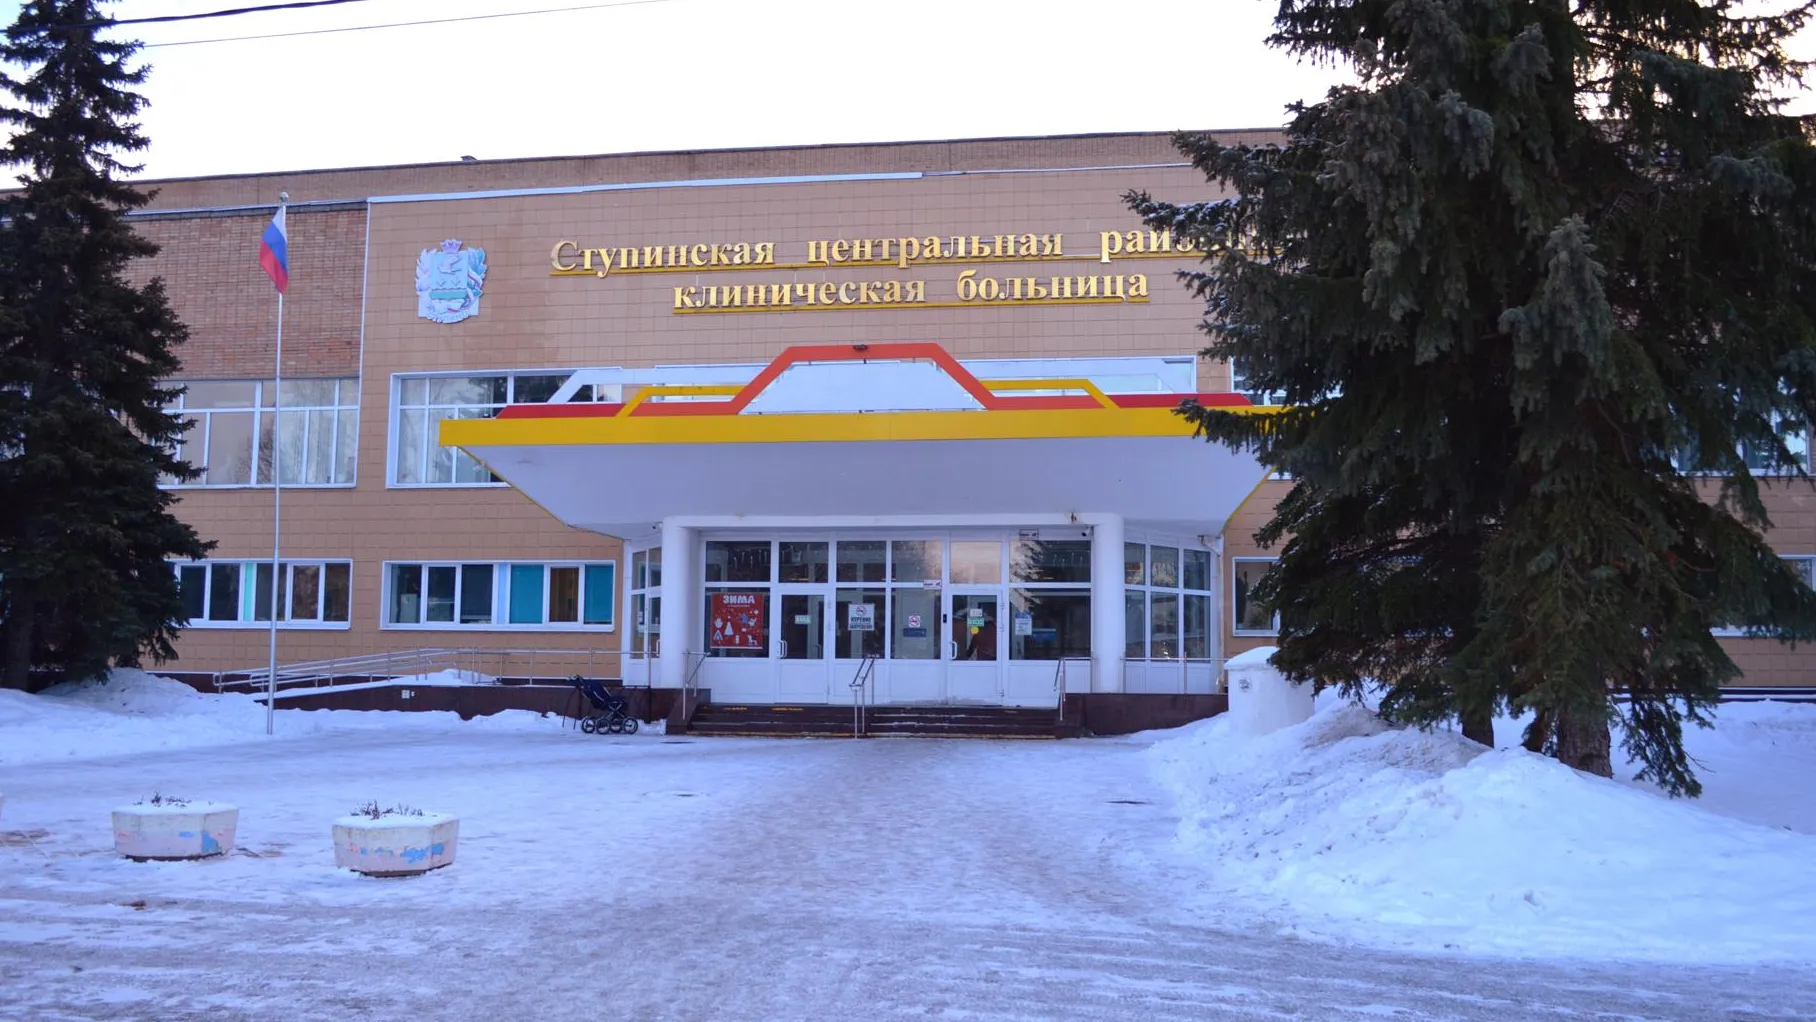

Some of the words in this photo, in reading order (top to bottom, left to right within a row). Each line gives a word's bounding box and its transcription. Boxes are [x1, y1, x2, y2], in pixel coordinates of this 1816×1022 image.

[551, 239, 776, 278] Ступинская
[807, 233, 1063, 269] центральная
[673, 279, 926, 309] клиническая
[956, 269, 1149, 302] больница
[723, 594, 756, 604] ЗИМА
